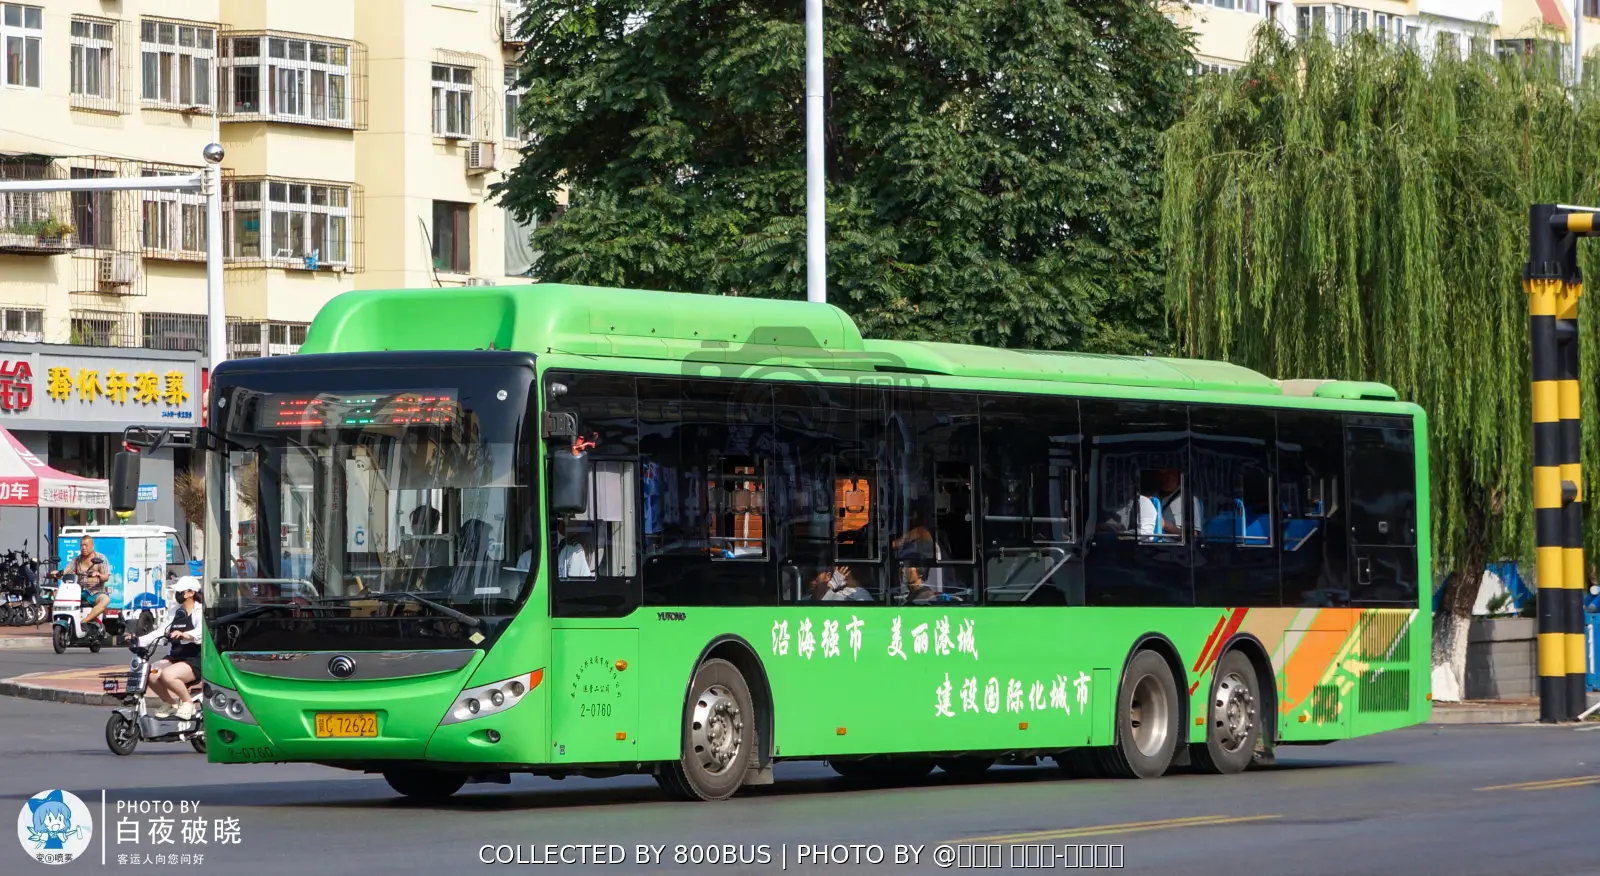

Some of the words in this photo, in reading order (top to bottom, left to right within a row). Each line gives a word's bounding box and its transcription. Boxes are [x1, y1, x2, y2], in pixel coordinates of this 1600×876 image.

[46, 367, 191, 405] 释怀轩殡葬
[657, 611, 687, 621] YUTONG
[771, 615, 865, 662] 沿海强市
[887, 615, 979, 661] 美丽港城
[934, 671, 1092, 718] 建设国际化城市
[580, 703, 612, 717] 2-0760
[227, 746, 274, 761] 2-0760
